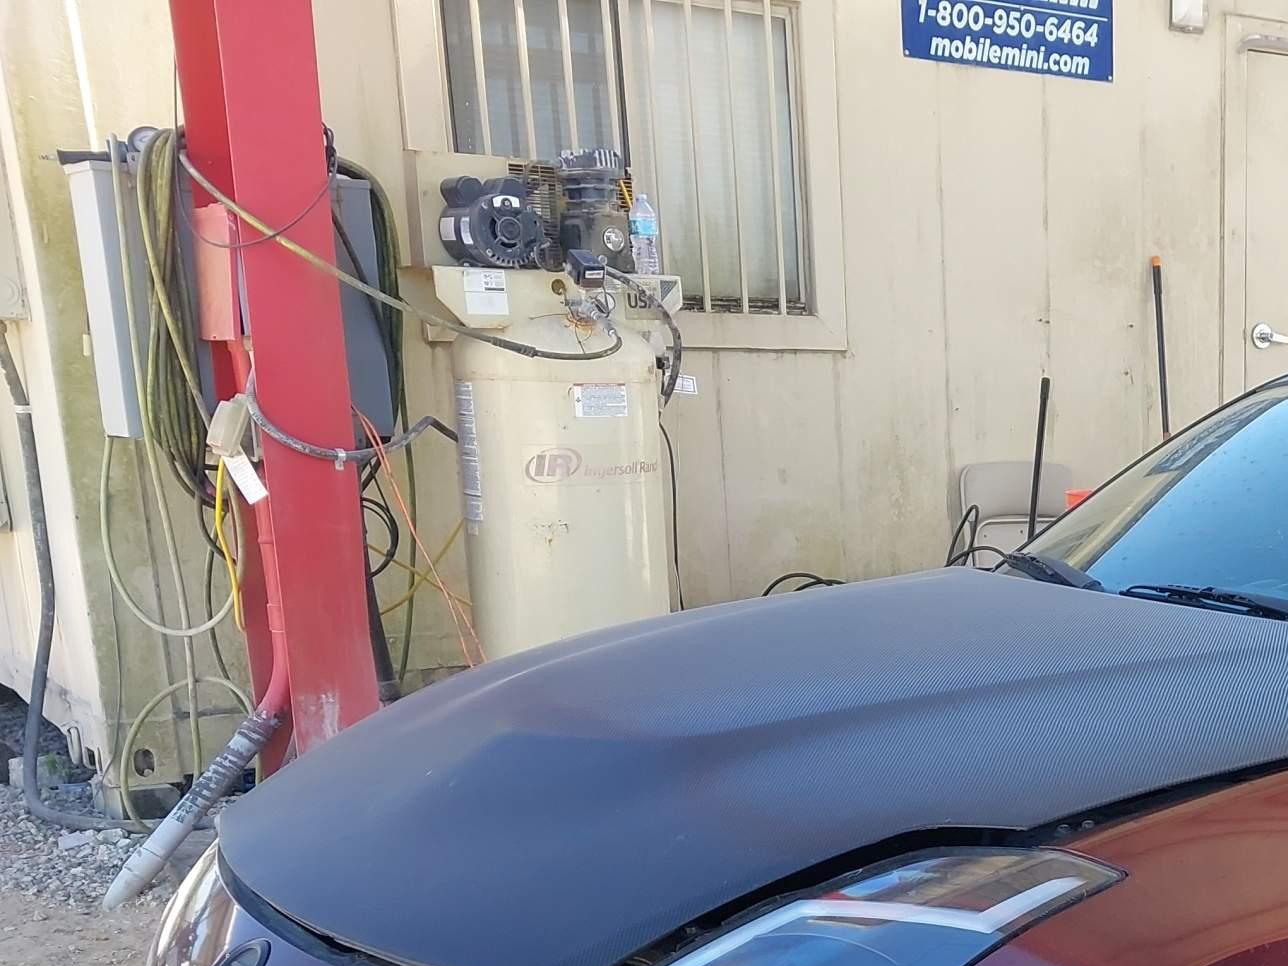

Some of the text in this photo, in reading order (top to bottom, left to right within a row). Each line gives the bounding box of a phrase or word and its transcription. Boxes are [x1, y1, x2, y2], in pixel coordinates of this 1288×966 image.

[918, 0, 1098, 47] 1-800-950-6464
[930, 36, 1090, 75] mobilemini.com
[627, 292, 652, 309] US
